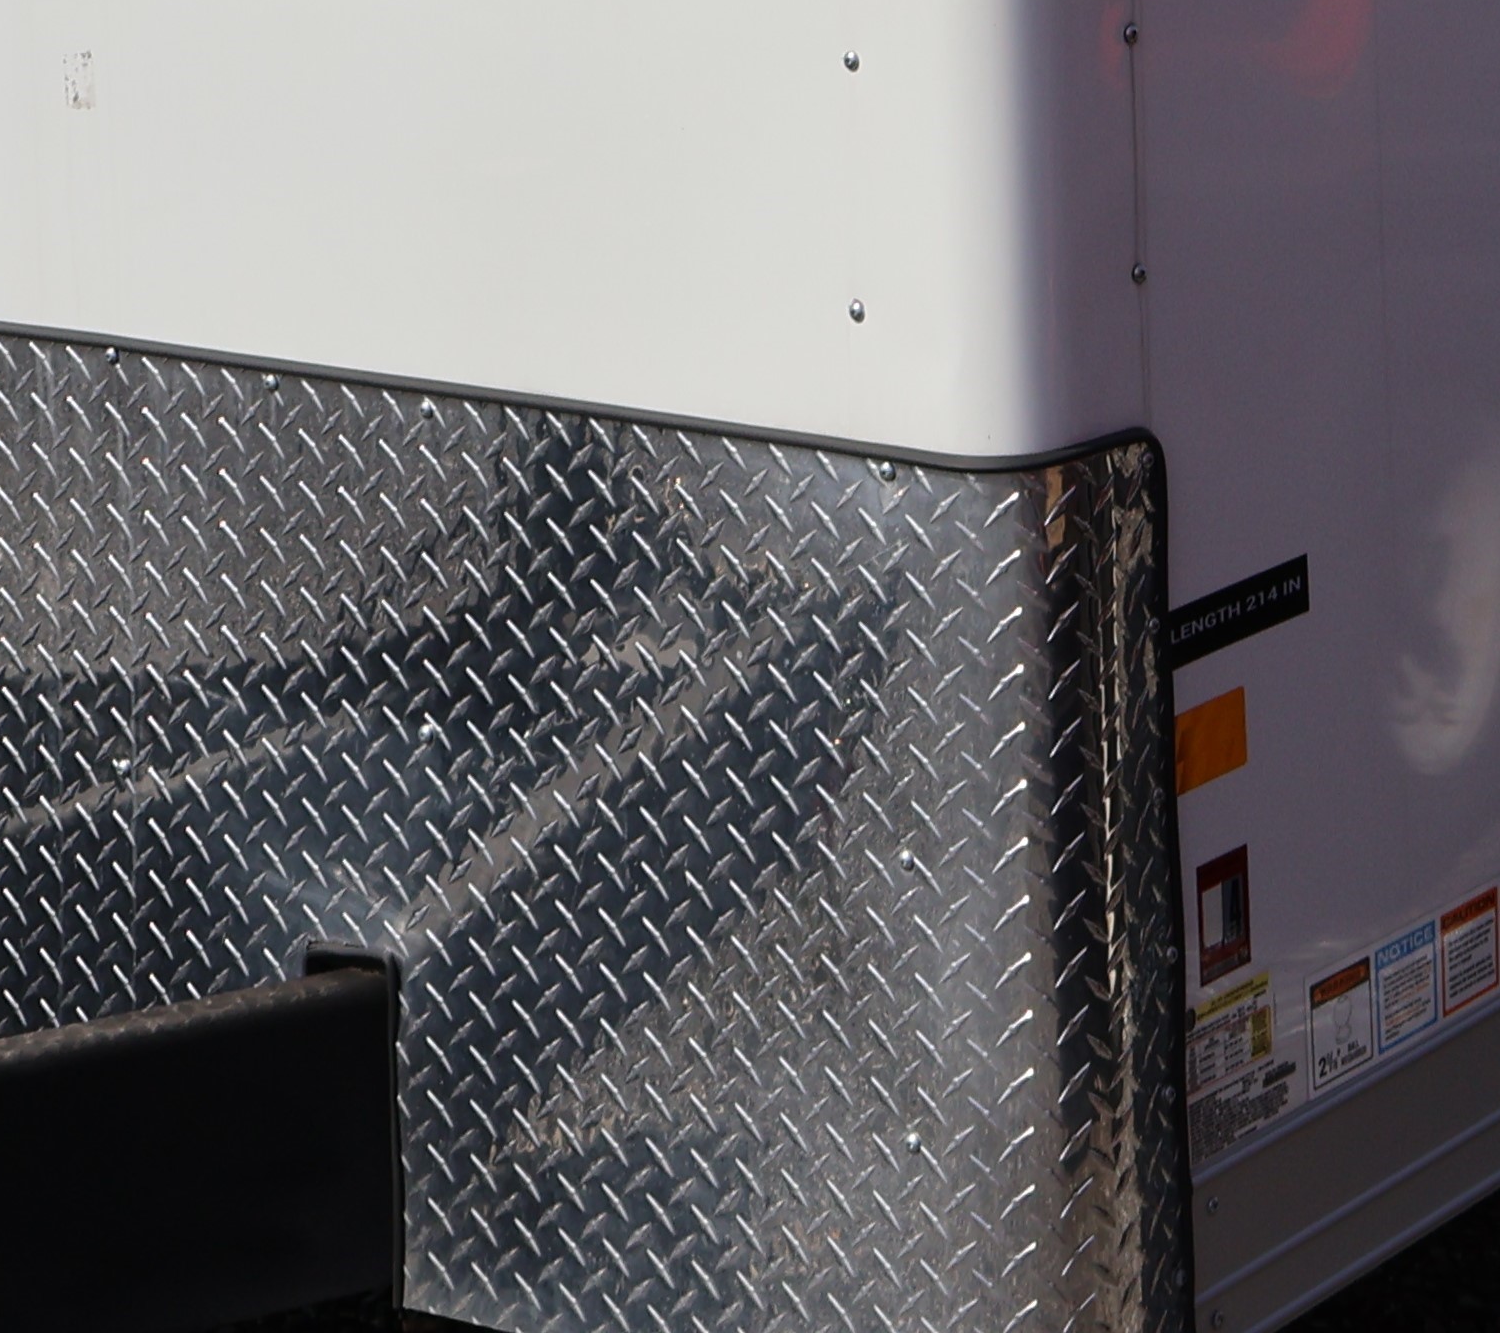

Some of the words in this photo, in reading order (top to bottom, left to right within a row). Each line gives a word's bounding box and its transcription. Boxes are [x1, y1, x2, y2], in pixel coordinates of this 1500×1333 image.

[1170, 600, 1241, 644] LENGTH
[1246, 585, 1278, 612] 214
[1283, 576, 1301, 596] IN
[1441, 893, 1495, 929] CAUTION
[1377, 924, 1434, 966] NOTICE
